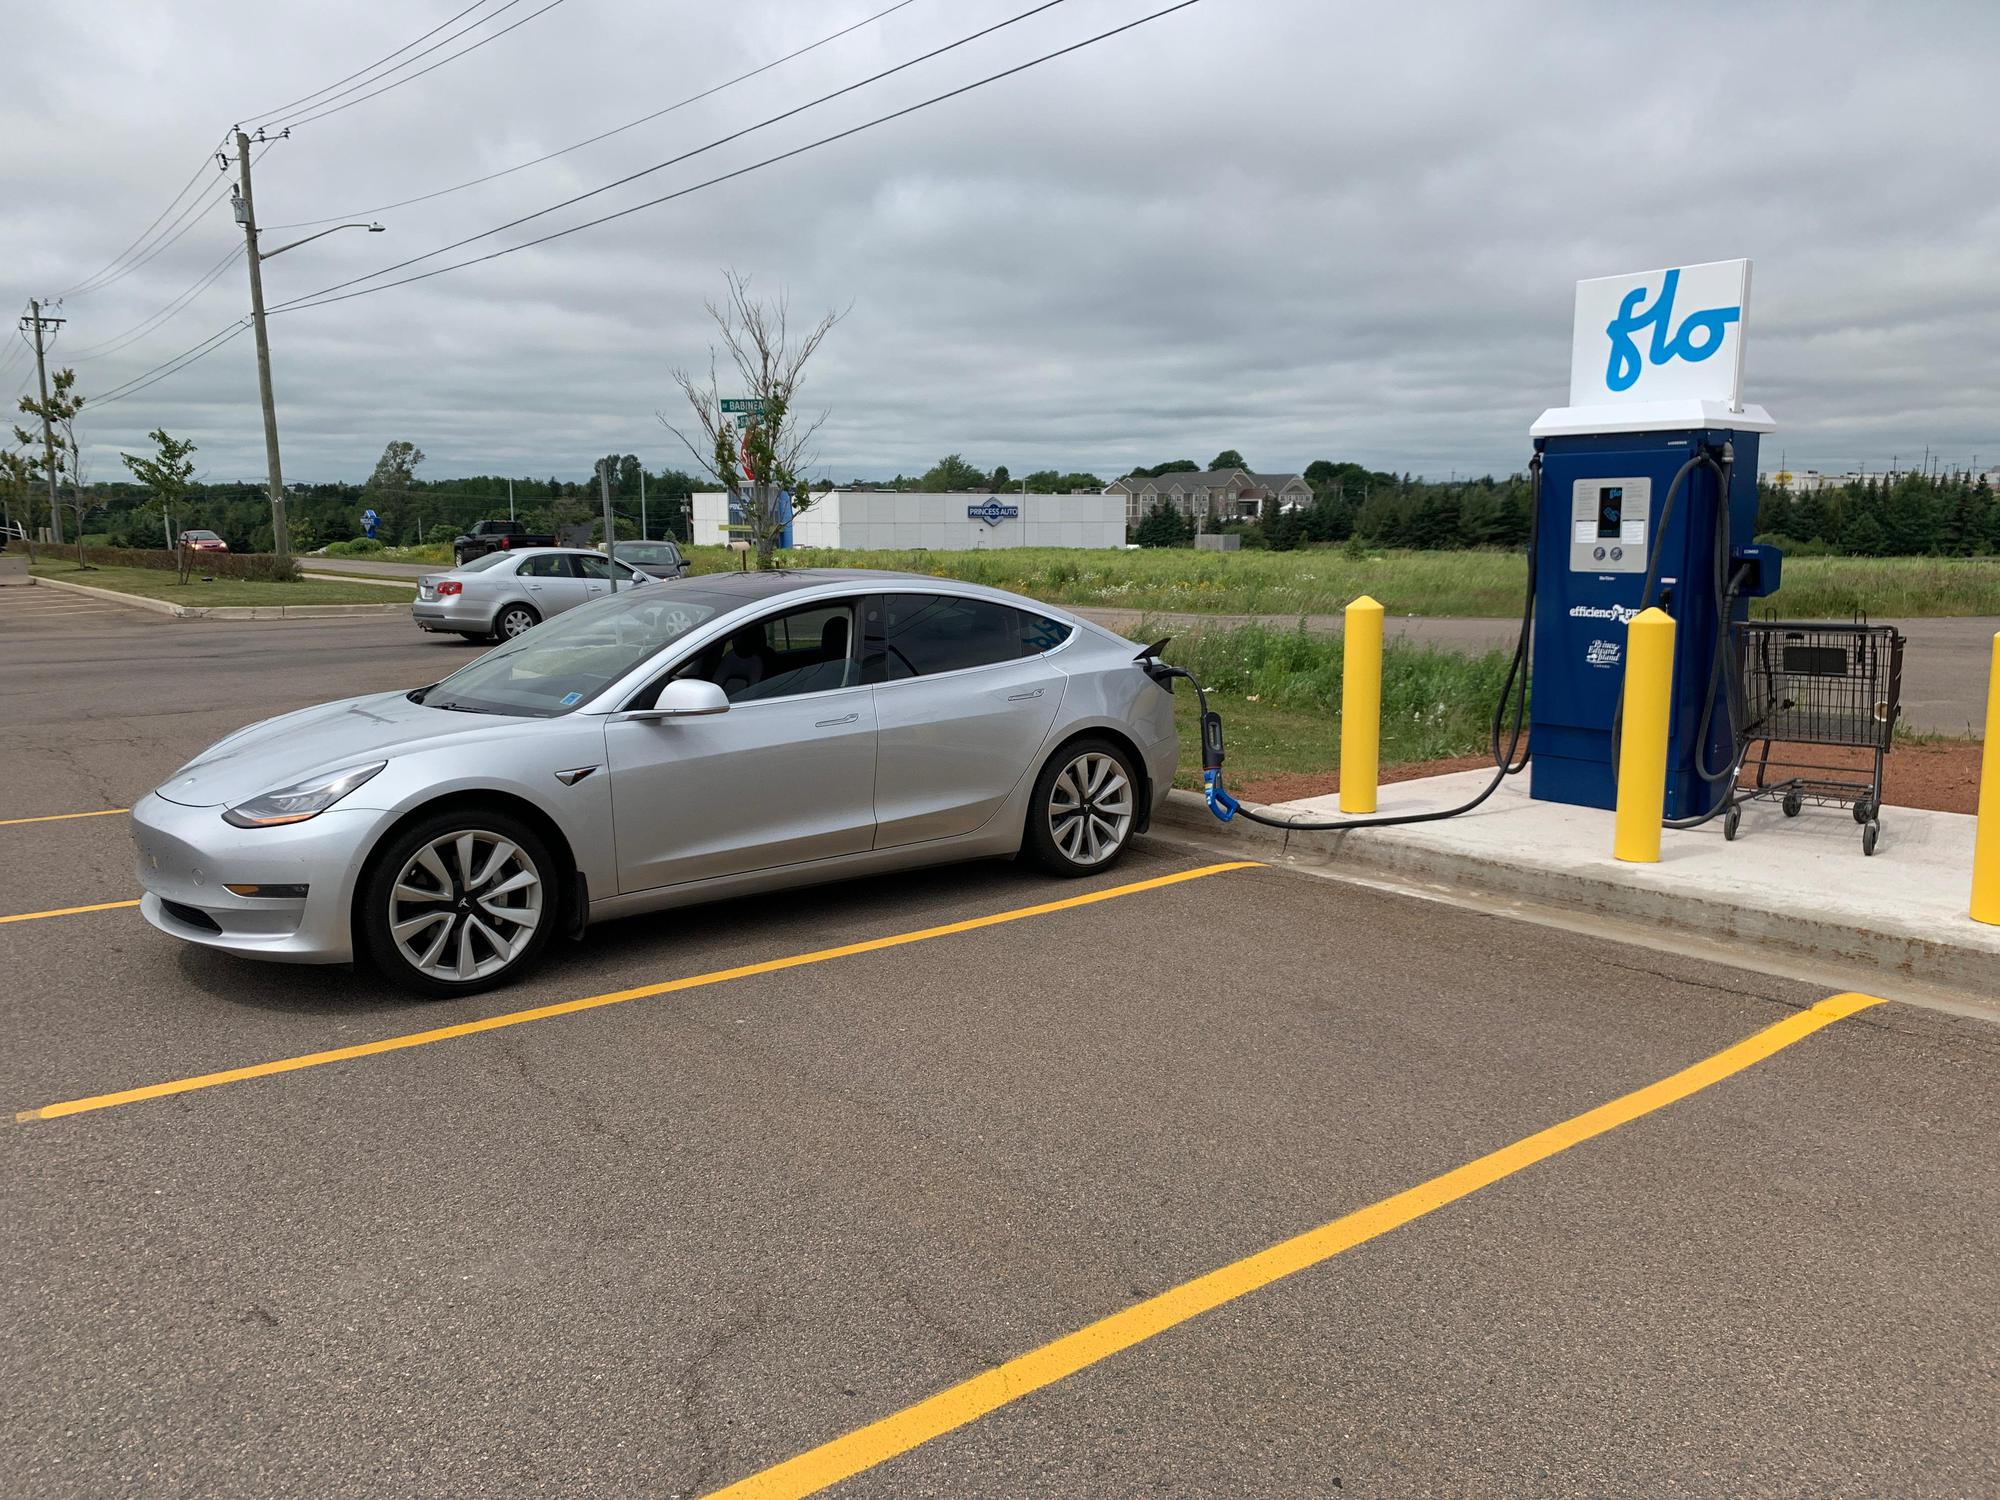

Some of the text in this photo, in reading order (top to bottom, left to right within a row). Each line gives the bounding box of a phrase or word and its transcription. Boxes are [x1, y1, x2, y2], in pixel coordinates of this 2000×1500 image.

[1606, 268, 1741, 391] flo
[730, 401, 765, 410] BABINEA
[970, 508, 1018, 516] PRINCESS AUTO
[1569, 606, 1617, 621] efficiency
[1591, 639, 1620, 650] Prince
[1588, 645, 1618, 655] Edward
[1597, 652, 1620, 661] Island
